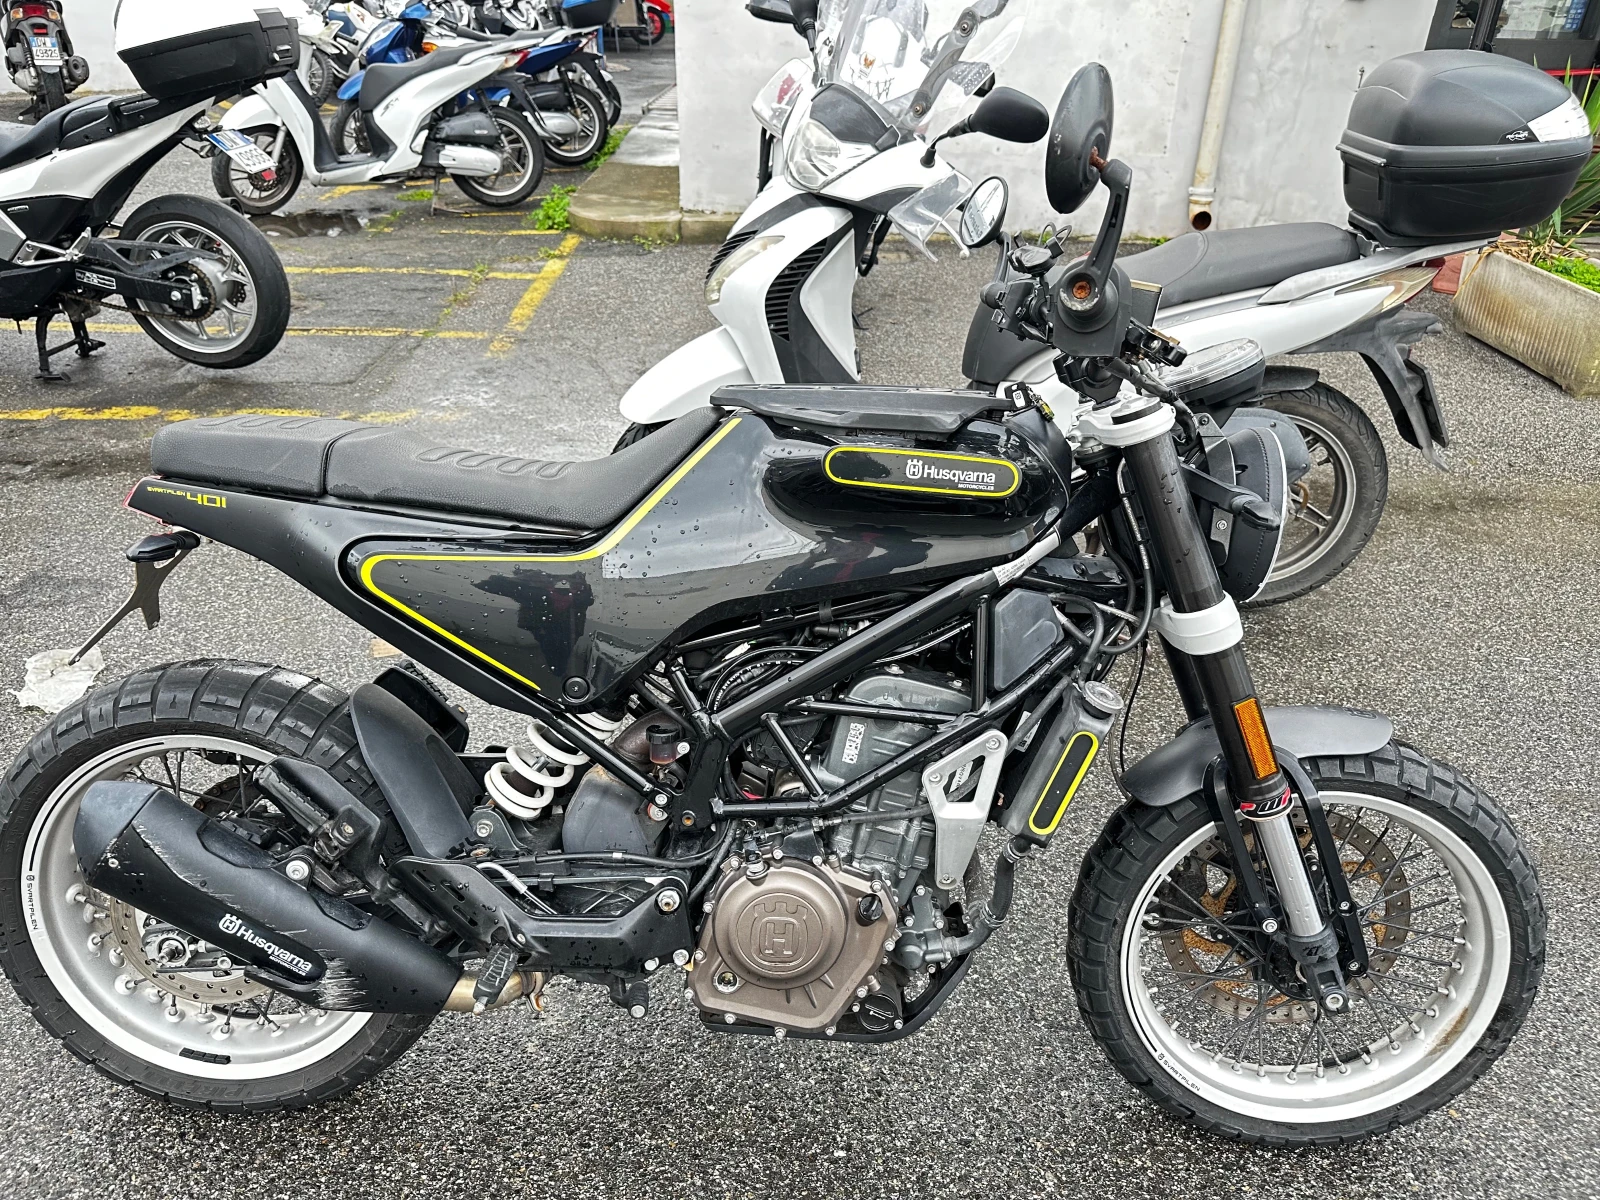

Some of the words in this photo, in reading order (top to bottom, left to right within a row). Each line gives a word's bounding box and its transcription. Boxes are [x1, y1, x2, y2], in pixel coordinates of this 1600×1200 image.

[35, 49, 59, 58] 49325
[923, 465, 996, 483] Husqvarna
[957, 483, 995, 491] MOTORCYCLES
[186, 491, 226, 508] 401
[27, 882, 39, 930] SVARTPILEN
[236, 925, 313, 971] Husqvarna
[268, 955, 308, 977] MOTORCYCLES
[1162, 1059, 1201, 1091] SVARTPILEN
